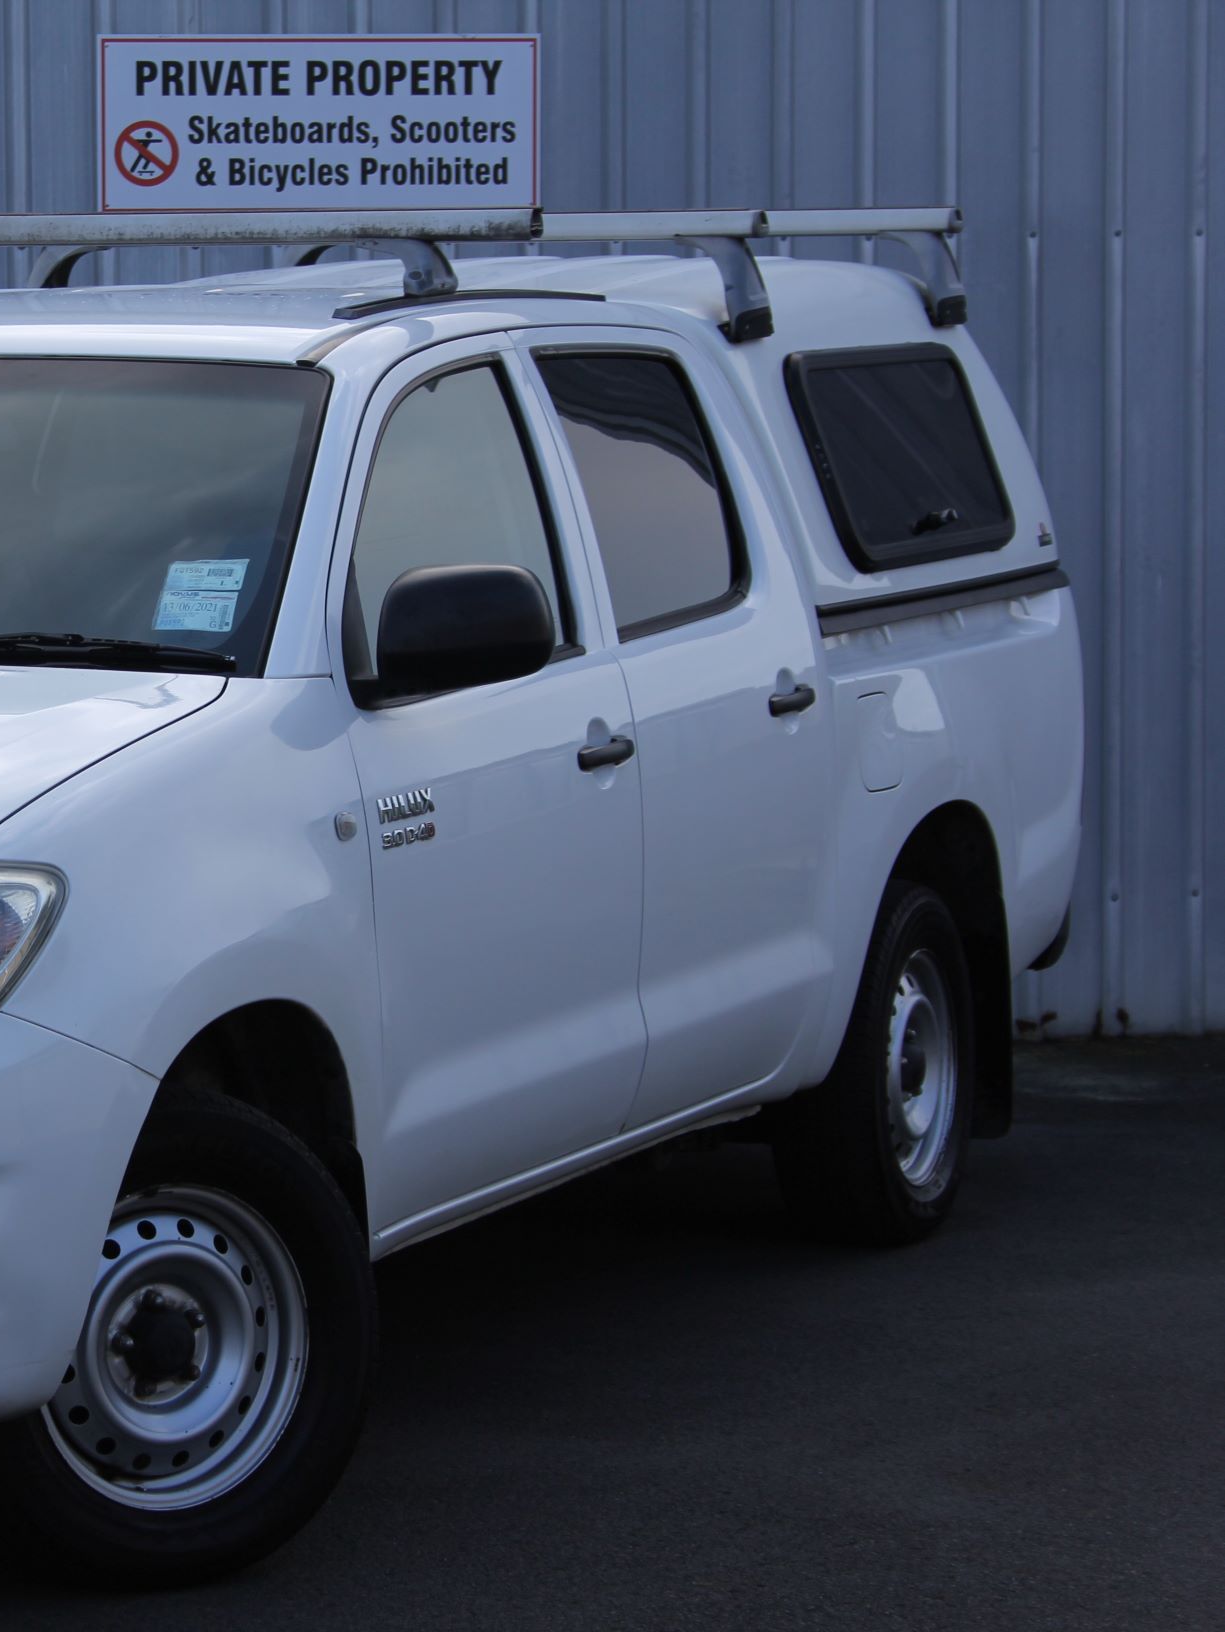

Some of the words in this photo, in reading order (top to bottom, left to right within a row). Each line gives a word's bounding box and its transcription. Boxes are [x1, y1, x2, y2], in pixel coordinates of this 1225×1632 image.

[135, 60, 290, 96] PRIVATE
[305, 60, 502, 96] PROPERTY
[187, 115, 379, 148] Skateboards,
[390, 115, 516, 143] Scooters
[195, 159, 216, 186] &
[228, 158, 349, 192] Bicycles
[360, 157, 509, 186] Prohibited
[377, 787, 435, 824] HILUX
